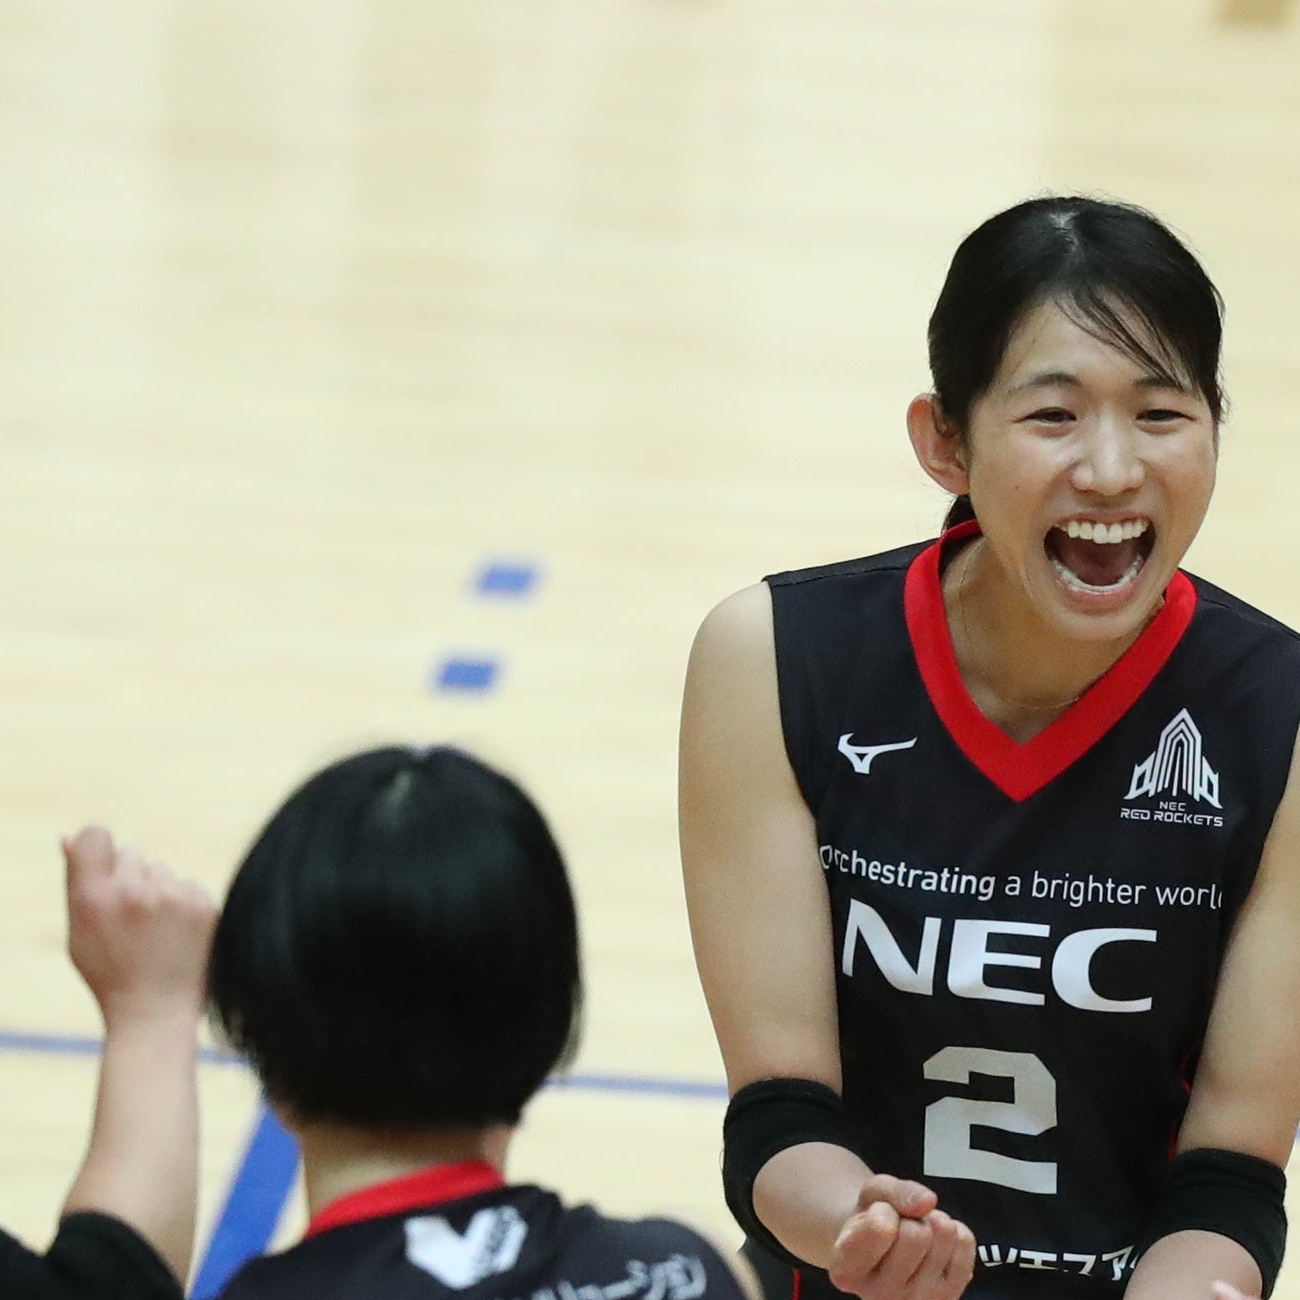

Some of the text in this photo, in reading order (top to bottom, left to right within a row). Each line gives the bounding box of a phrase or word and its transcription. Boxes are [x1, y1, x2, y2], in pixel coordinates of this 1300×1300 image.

[1120, 808, 1224, 827] RED ROCKETS
[1160, 801, 1186, 812] NEC
[1005, 874, 1020, 896] a
[1031, 870, 1146, 908] brighter
[1155, 884, 1223, 909] worl
[842, 898, 1157, 1013] NEC
[922, 1045, 1057, 1195] 2
